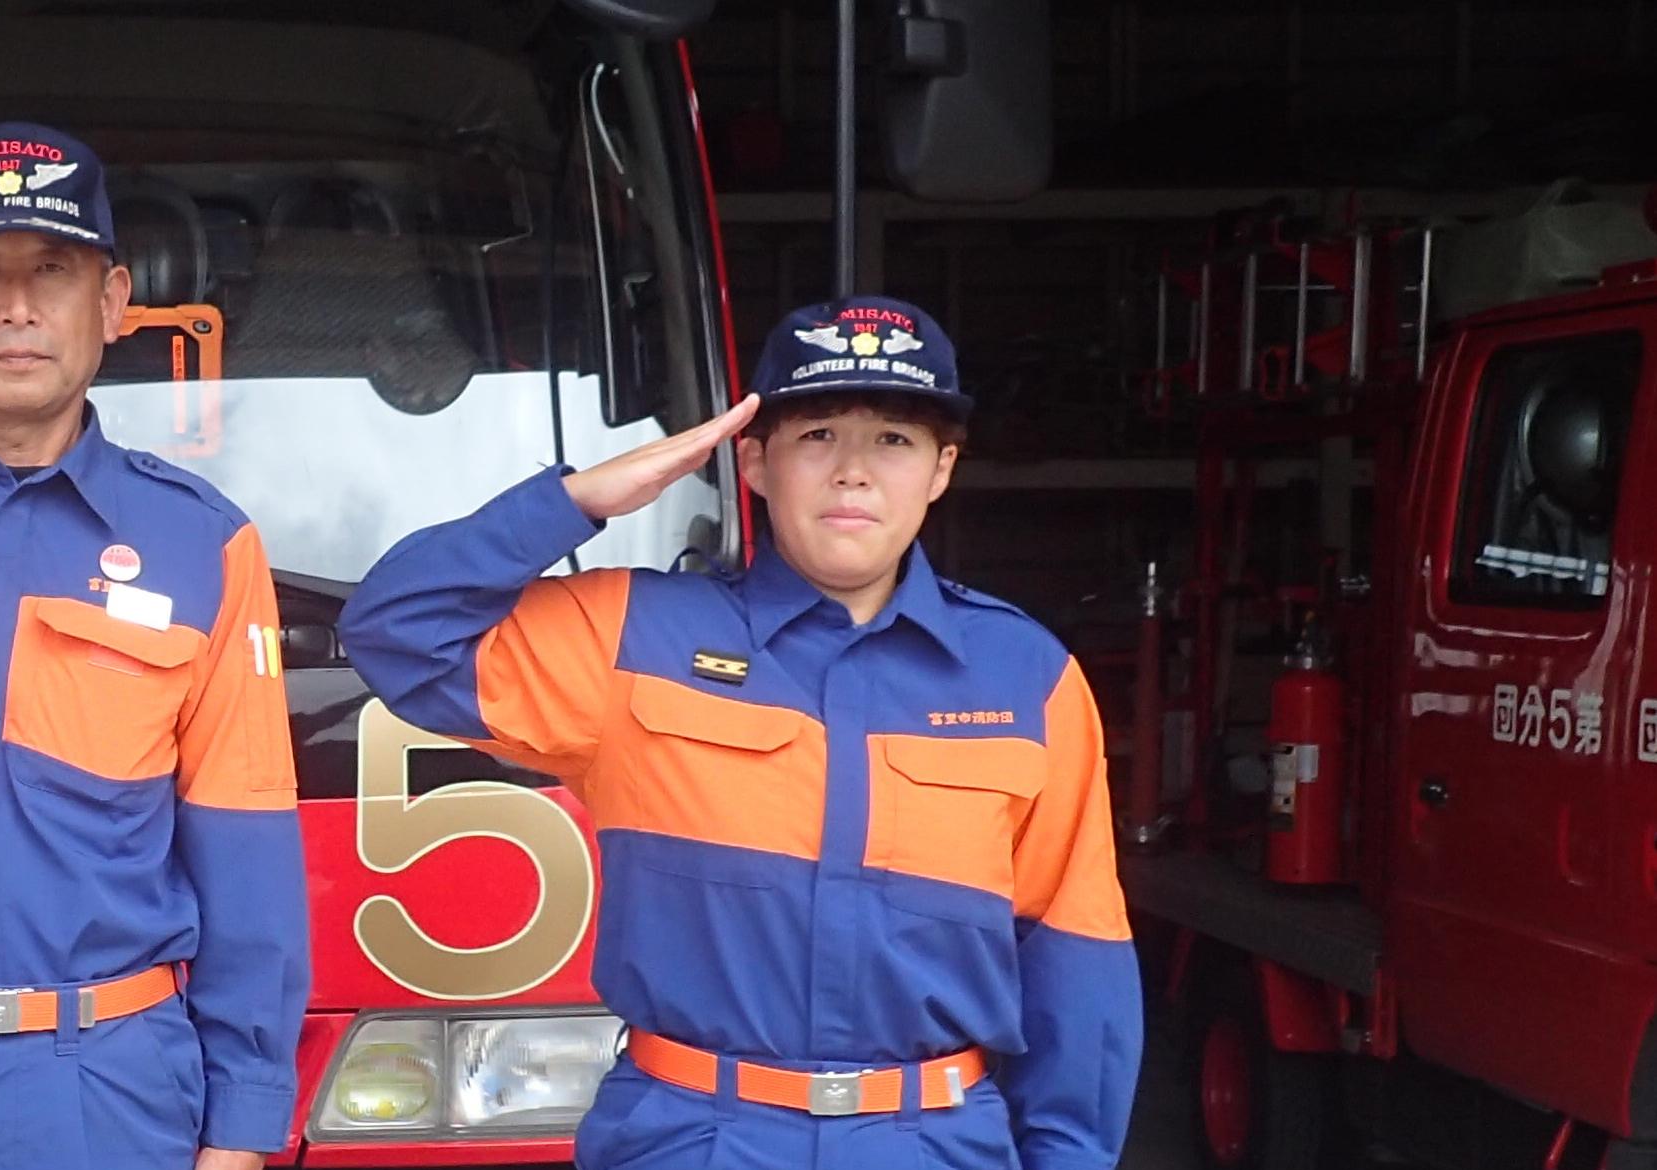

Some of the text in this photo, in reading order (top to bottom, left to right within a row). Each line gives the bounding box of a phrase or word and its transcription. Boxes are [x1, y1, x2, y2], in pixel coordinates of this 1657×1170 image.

[3, 197, 32, 208] FIRE
[36, 196, 80, 218] BRIGADE
[859, 358, 889, 371] FIRE
[354, 697, 594, 1000] 5
